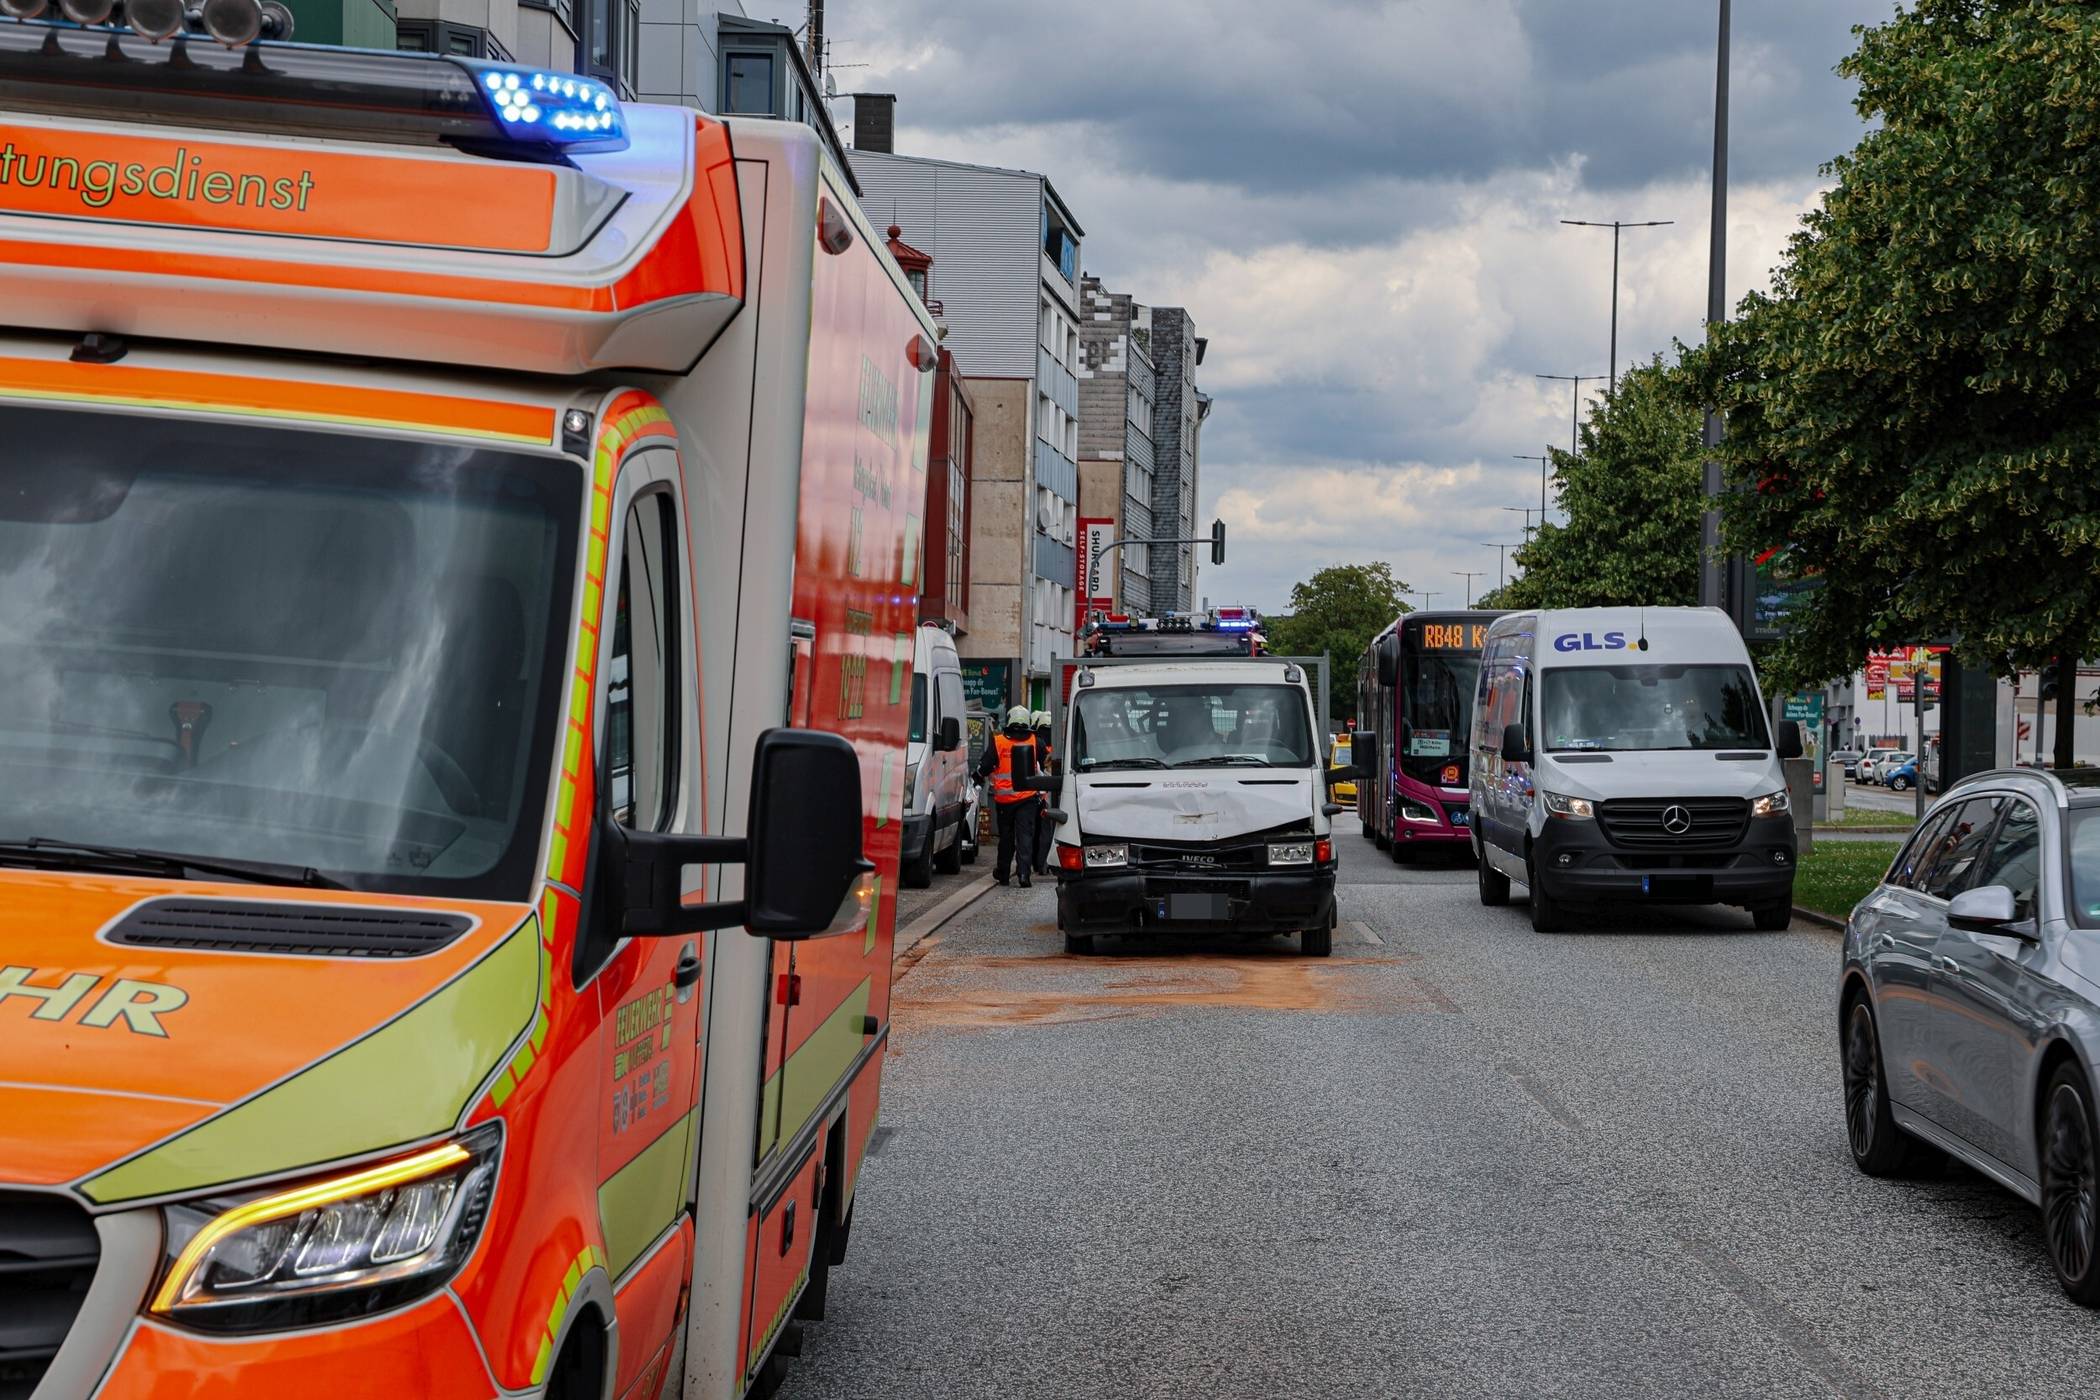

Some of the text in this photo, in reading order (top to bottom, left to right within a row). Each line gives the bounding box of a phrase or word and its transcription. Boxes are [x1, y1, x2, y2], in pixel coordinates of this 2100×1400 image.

[1424, 624, 1464, 649] RB48
[1182, 855, 1215, 863] IVECO
[615, 988, 662, 1049] FEUERWEHR
